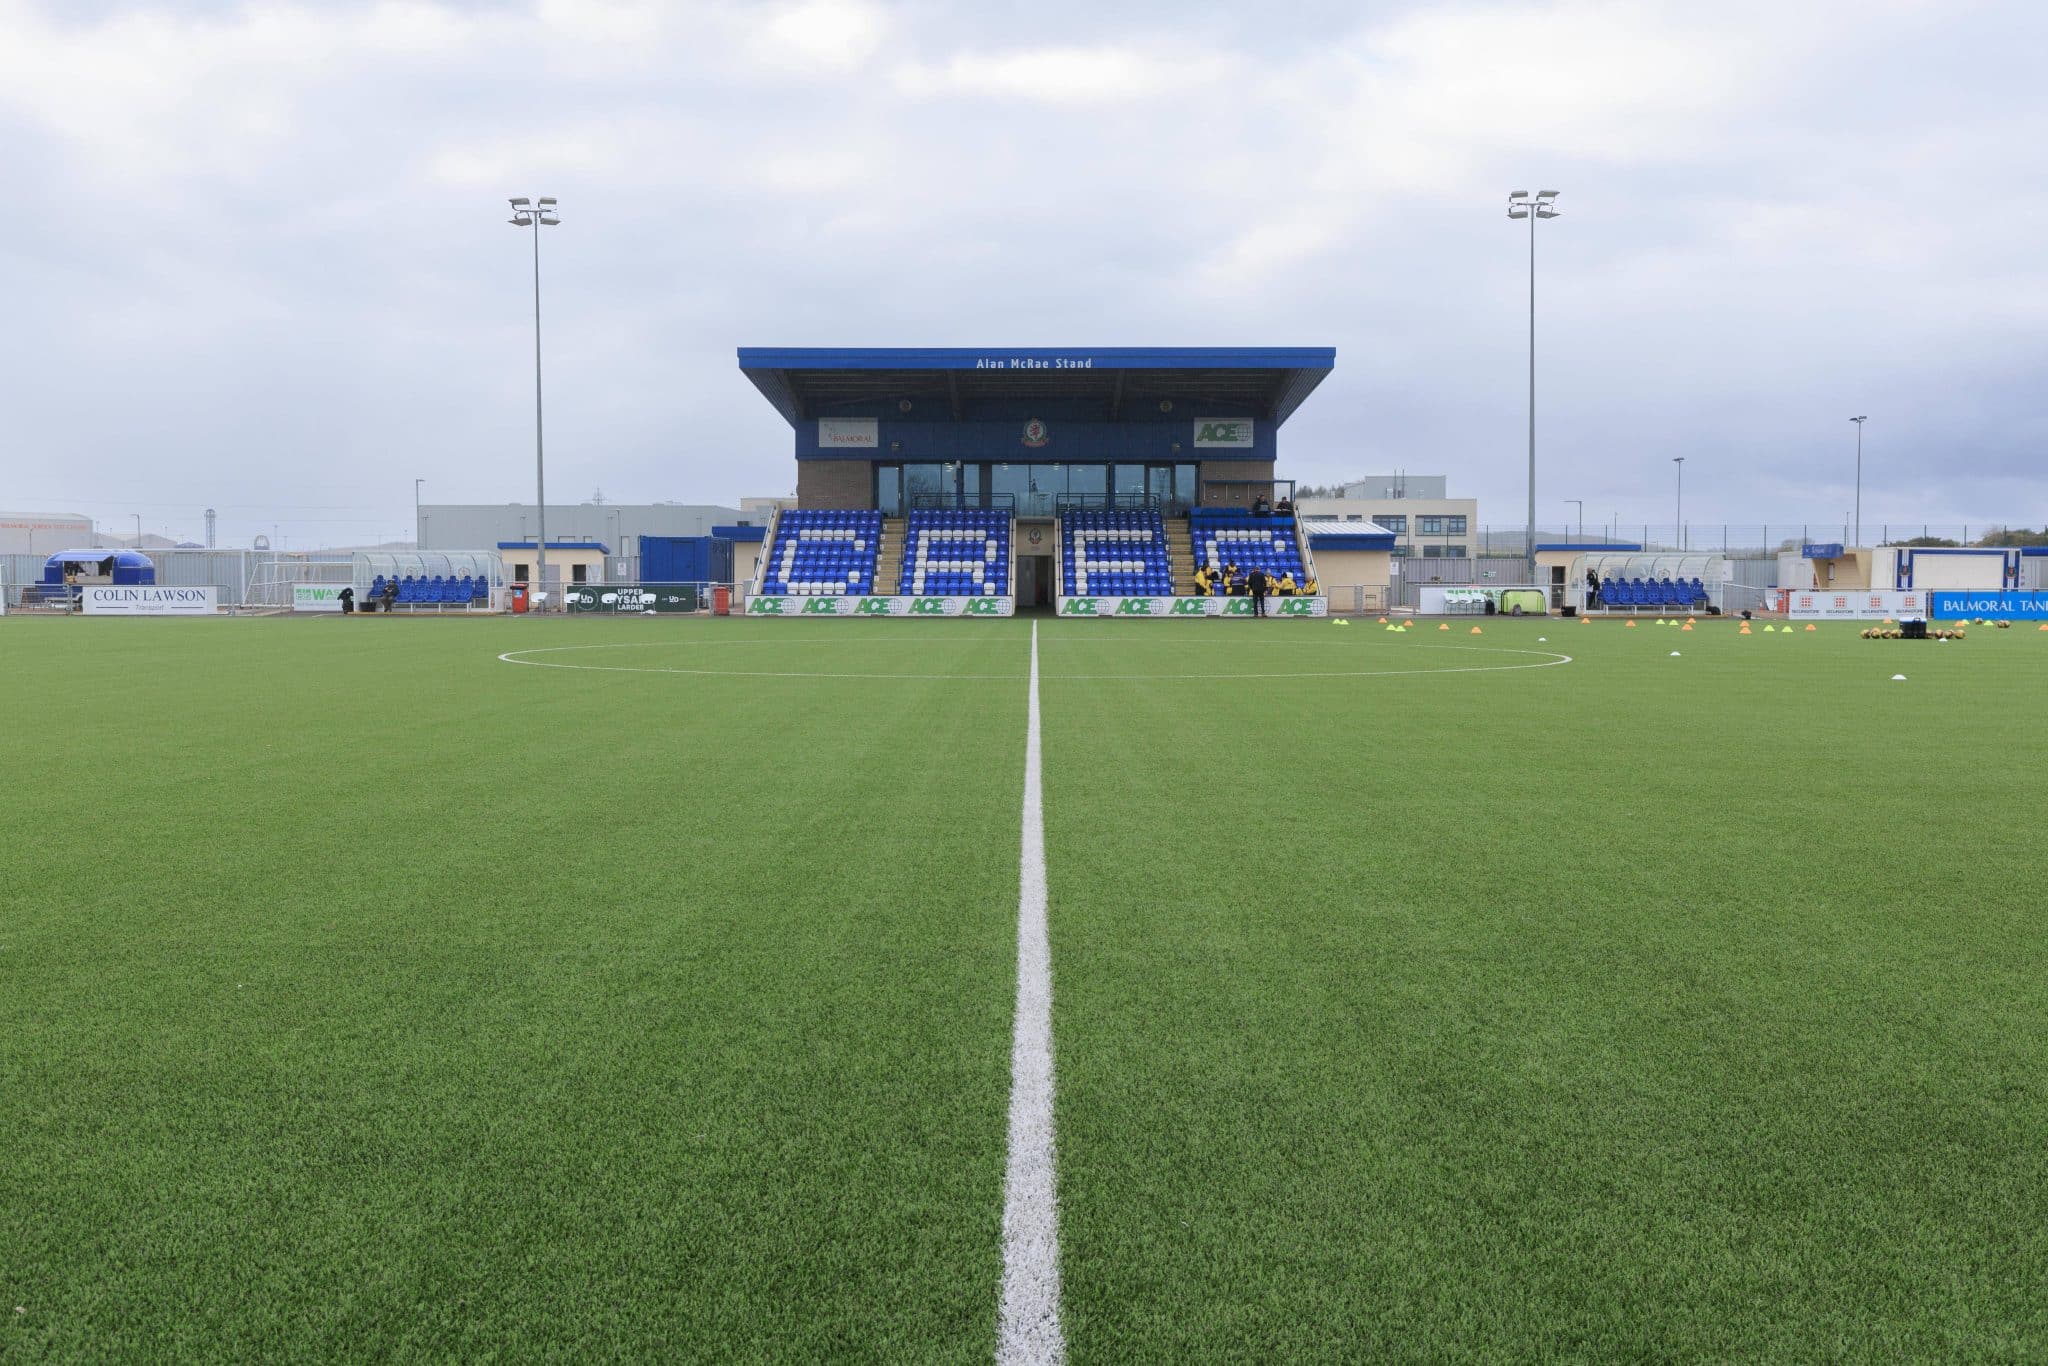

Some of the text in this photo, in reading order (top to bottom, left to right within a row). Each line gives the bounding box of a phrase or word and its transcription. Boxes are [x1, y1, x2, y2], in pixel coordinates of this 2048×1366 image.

[976, 358, 1092, 369] Alan McRae Stand
[1196, 423, 1240, 441] ACE
[93, 589, 206, 601] COLIN LAWSON
[747, 598, 786, 614] ACE
[800, 598, 839, 614] ACE
[854, 598, 893, 614] ACE
[908, 598, 946, 614] ACE
[962, 598, 1000, 614] ACE
[1061, 598, 1100, 614] ACE
[1115, 598, 1154, 614] ACE
[1169, 598, 1208, 614] ACE
[1276, 598, 1315, 614] ACE
[1943, 600, 2048, 612] BALMORAL TAN
